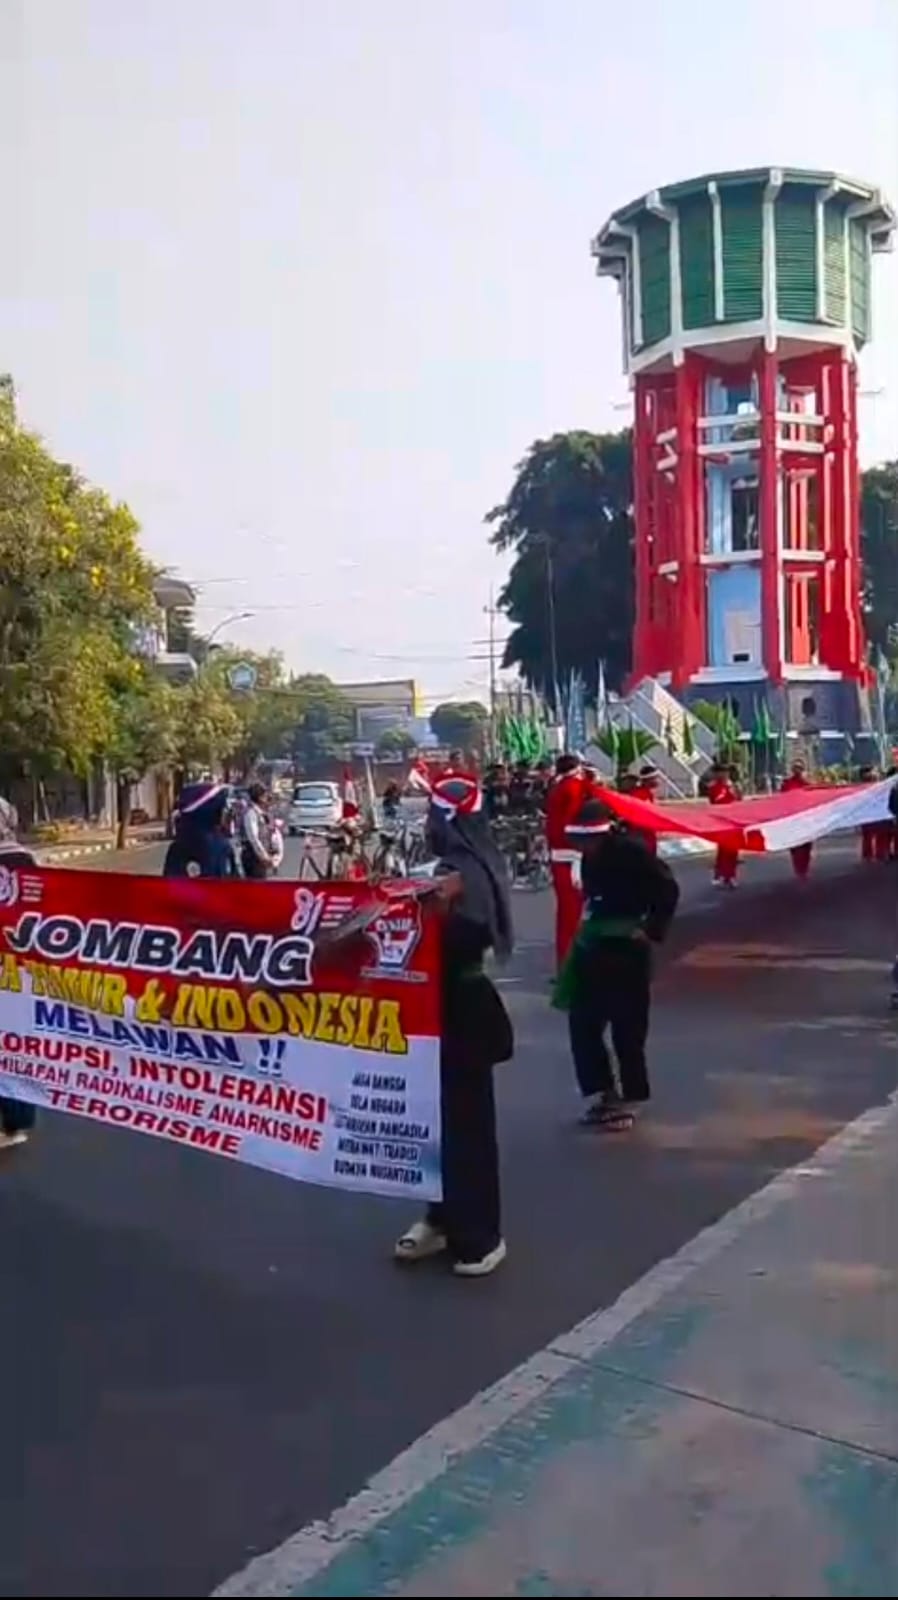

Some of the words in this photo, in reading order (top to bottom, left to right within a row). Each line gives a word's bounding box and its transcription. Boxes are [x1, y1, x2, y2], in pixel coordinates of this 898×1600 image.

[3, 911, 314, 985] JOMBANG
[34, 1000, 242, 1065] MELAWAN
[258, 1039, 287, 1074] !!
[136, 979, 166, 1022] &
[172, 984, 408, 1055] INDONESIA
[0, 1030, 119, 1077] ORUPSI,
[130, 1055, 326, 1124] INTOLERANSI
[76, 1071, 205, 1118] RADIKALISME
[208, 1103, 322, 1151] ANARKISME
[47, 1088, 242, 1154] TERORISME
